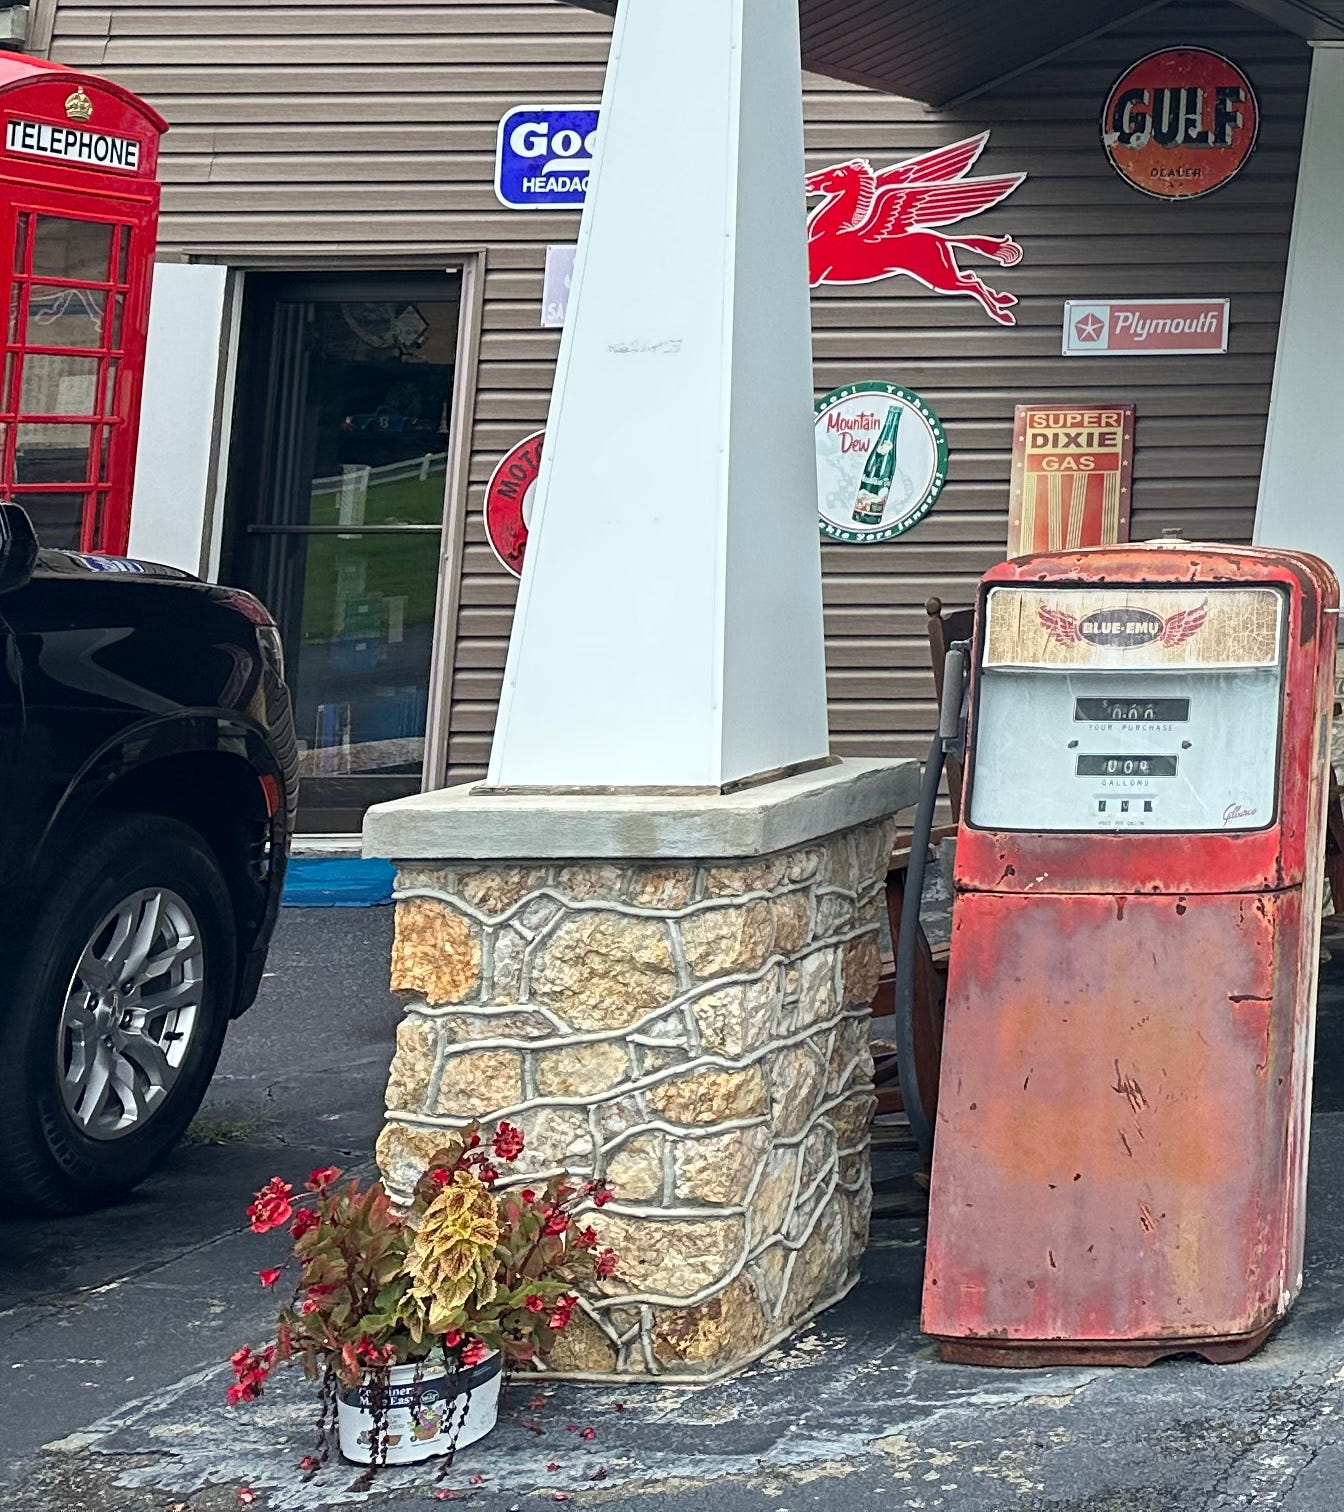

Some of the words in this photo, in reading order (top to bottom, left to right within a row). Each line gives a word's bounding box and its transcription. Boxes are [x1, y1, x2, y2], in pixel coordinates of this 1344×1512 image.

[1112, 85, 1246, 150] GULF
[8, 119, 138, 168] TELEPHONE
[1113, 311, 1219, 341] Plymouth
[826, 411, 881, 434] Mountain
[1033, 413, 1119, 428] SUPER
[838, 431, 870, 454] Dew
[1031, 431, 1118, 449] DIXIE
[1041, 456, 1096, 470] GAS
[1089, 724, 1113, 732] YOUR
[1122, 724, 1173, 732] PURCHASE
[1101, 779, 1150, 787] GALLONS
